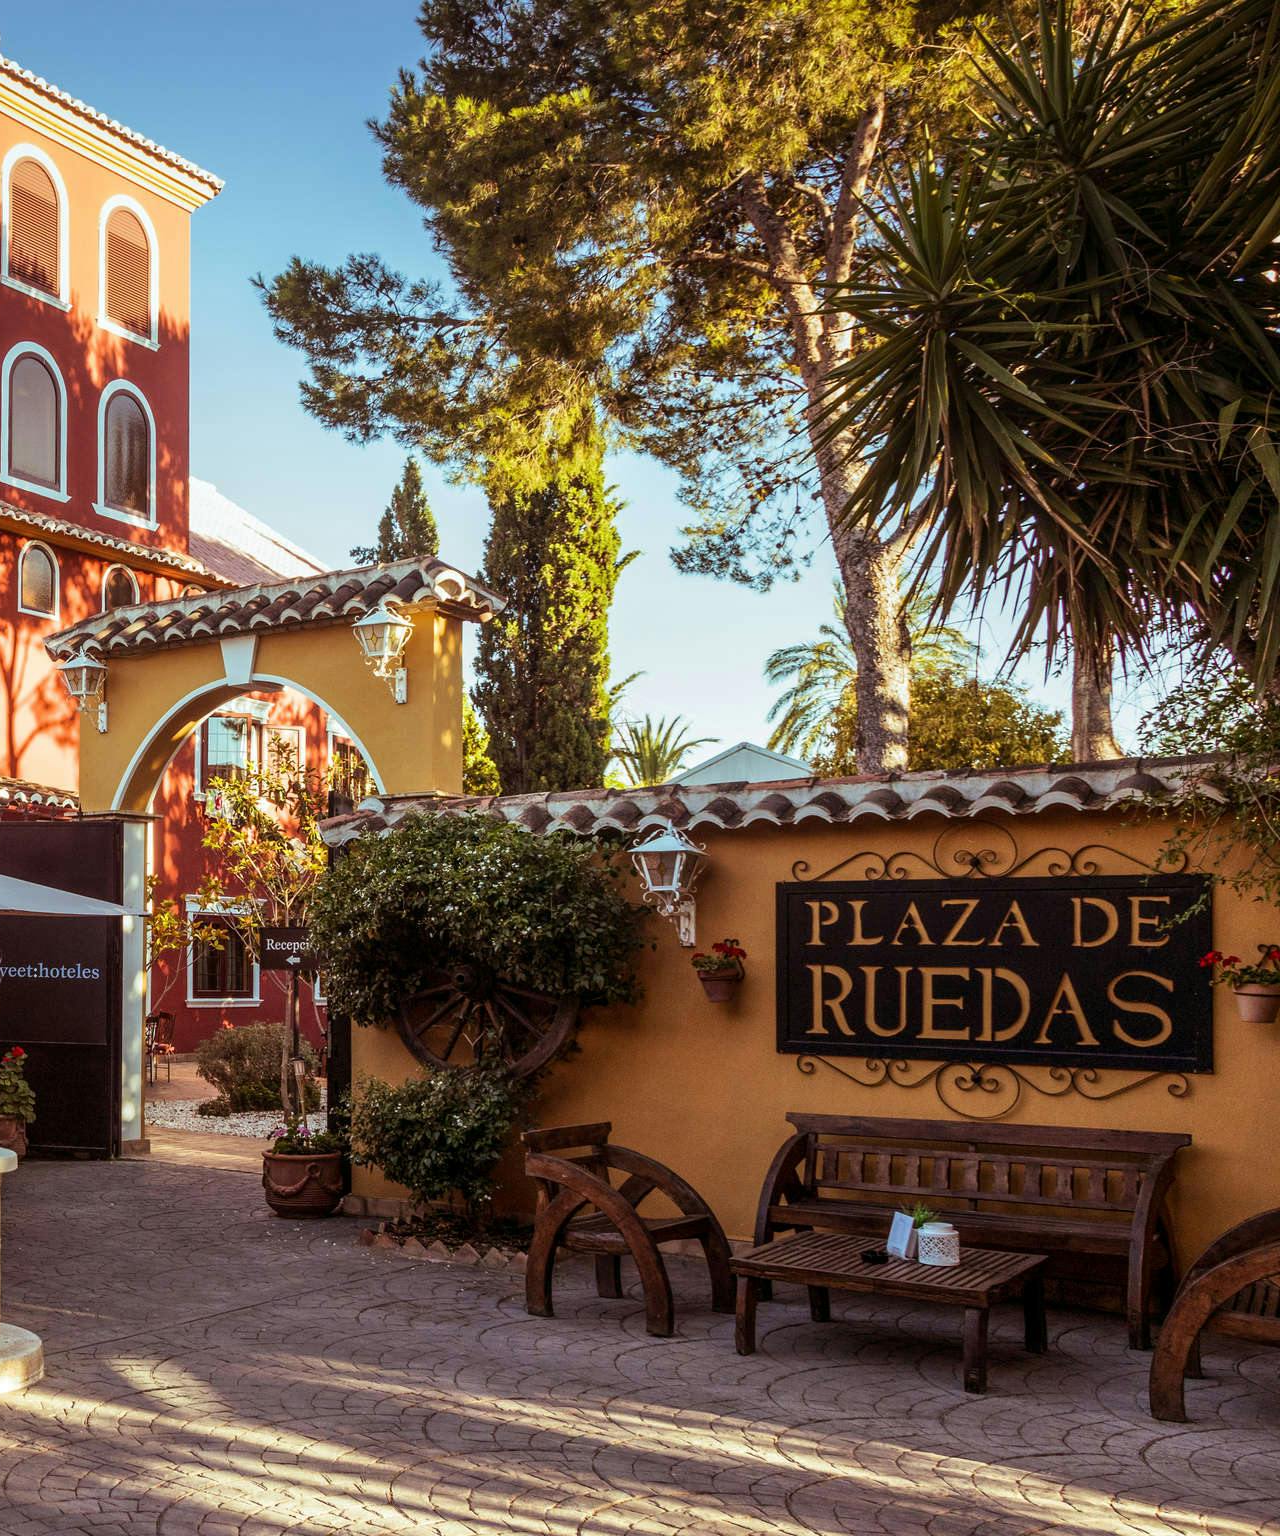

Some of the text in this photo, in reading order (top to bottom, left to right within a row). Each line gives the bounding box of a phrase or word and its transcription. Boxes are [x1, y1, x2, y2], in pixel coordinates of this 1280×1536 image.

[266, 938, 311, 954] Recepci
[805, 896, 1171, 948] PLAZA DE
[805, 964, 1174, 1047] RUEDAS
